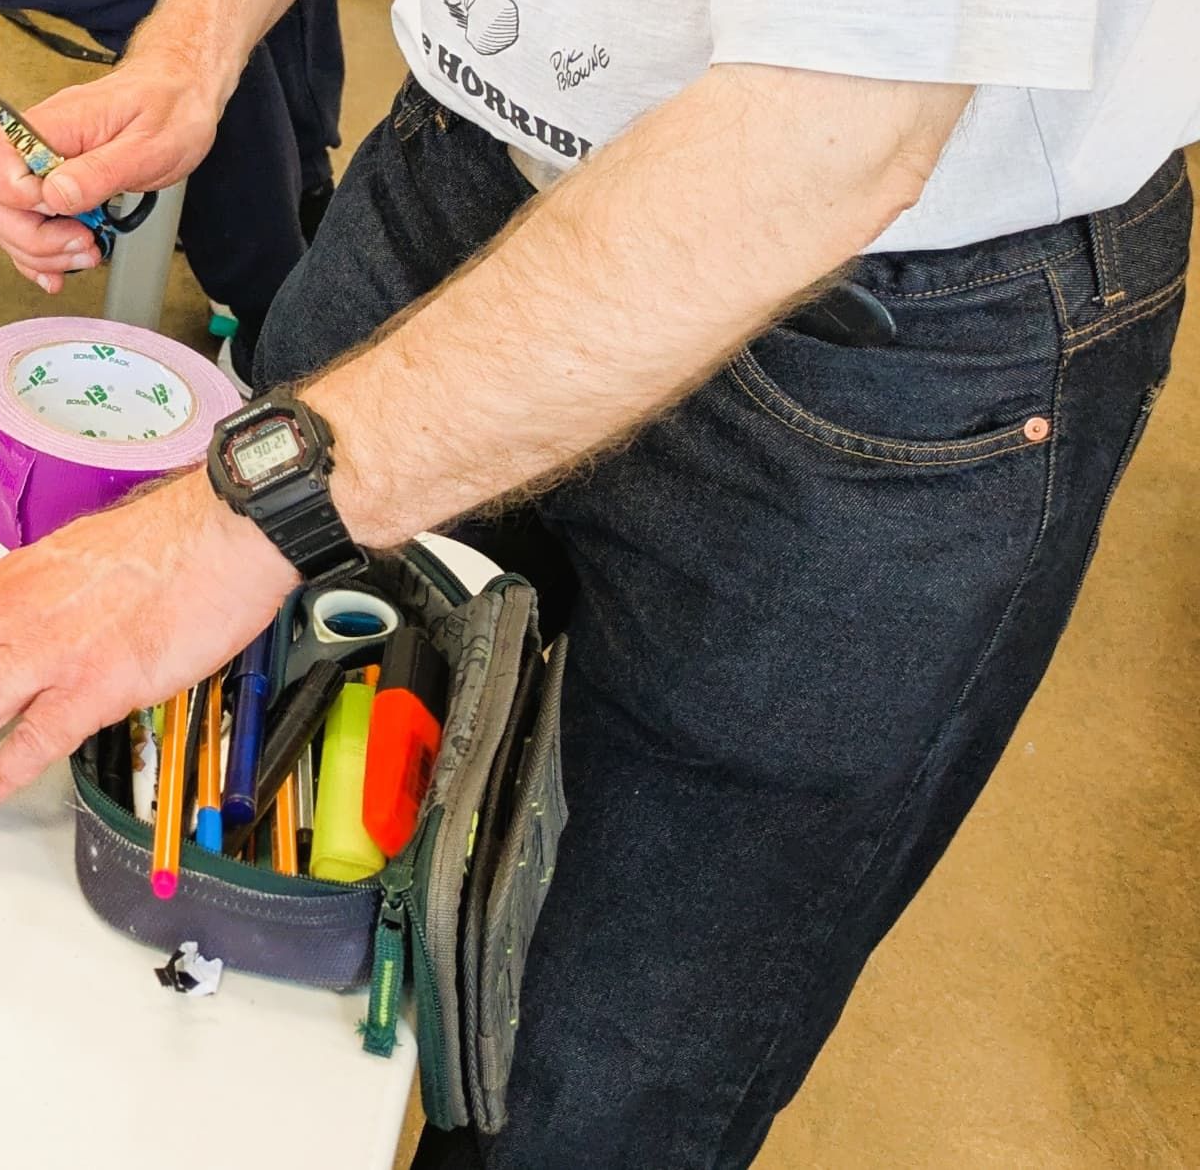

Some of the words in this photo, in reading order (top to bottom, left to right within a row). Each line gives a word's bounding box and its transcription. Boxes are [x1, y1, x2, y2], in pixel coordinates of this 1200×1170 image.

[556, 44, 610, 91] BROWNE
[108, 357, 131, 367] PACK
[101, 402, 123, 414] PACK
[224, 402, 272, 429] G-SHOCK
